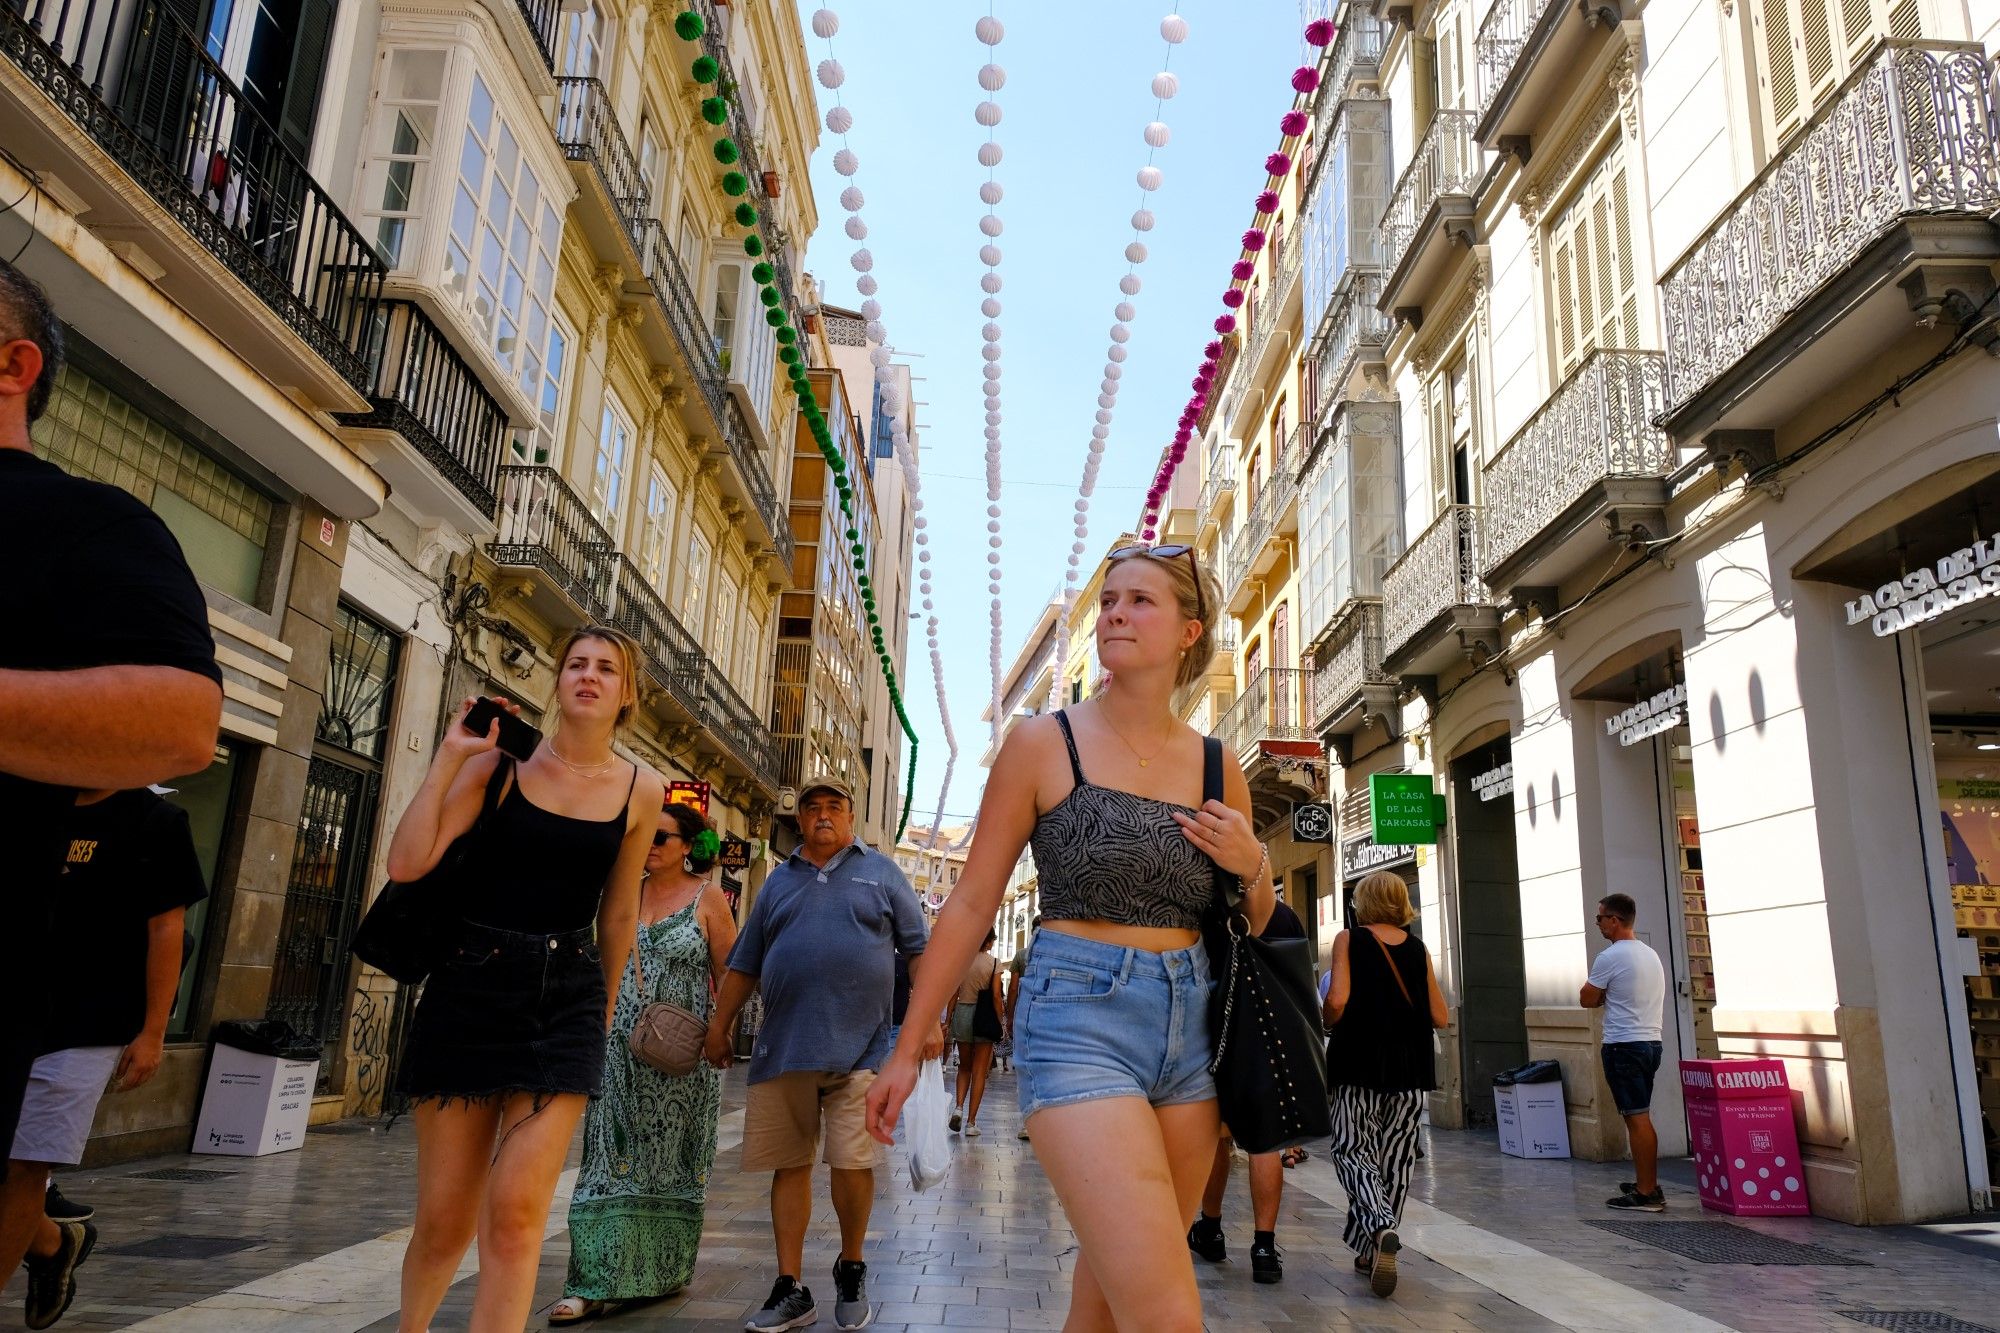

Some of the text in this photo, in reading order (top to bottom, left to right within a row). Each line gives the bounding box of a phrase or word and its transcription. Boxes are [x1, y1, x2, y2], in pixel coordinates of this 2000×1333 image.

[1844, 594, 1879, 625] LA
[1875, 567, 1938, 609] CASA
[1937, 548, 1975, 584] DE
[1606, 715, 1623, 735] LA
[1383, 791, 1425, 800] LA CASA
[1386, 805, 1423, 813] DE LAS
[1380, 819, 1431, 827] CARCASAS
[726, 843, 742, 856] 24
[721, 856, 746, 866] HORAS
[1682, 1069, 1714, 1089] CARTOJAL
[1717, 1070, 1784, 1090] CARTOJAL
